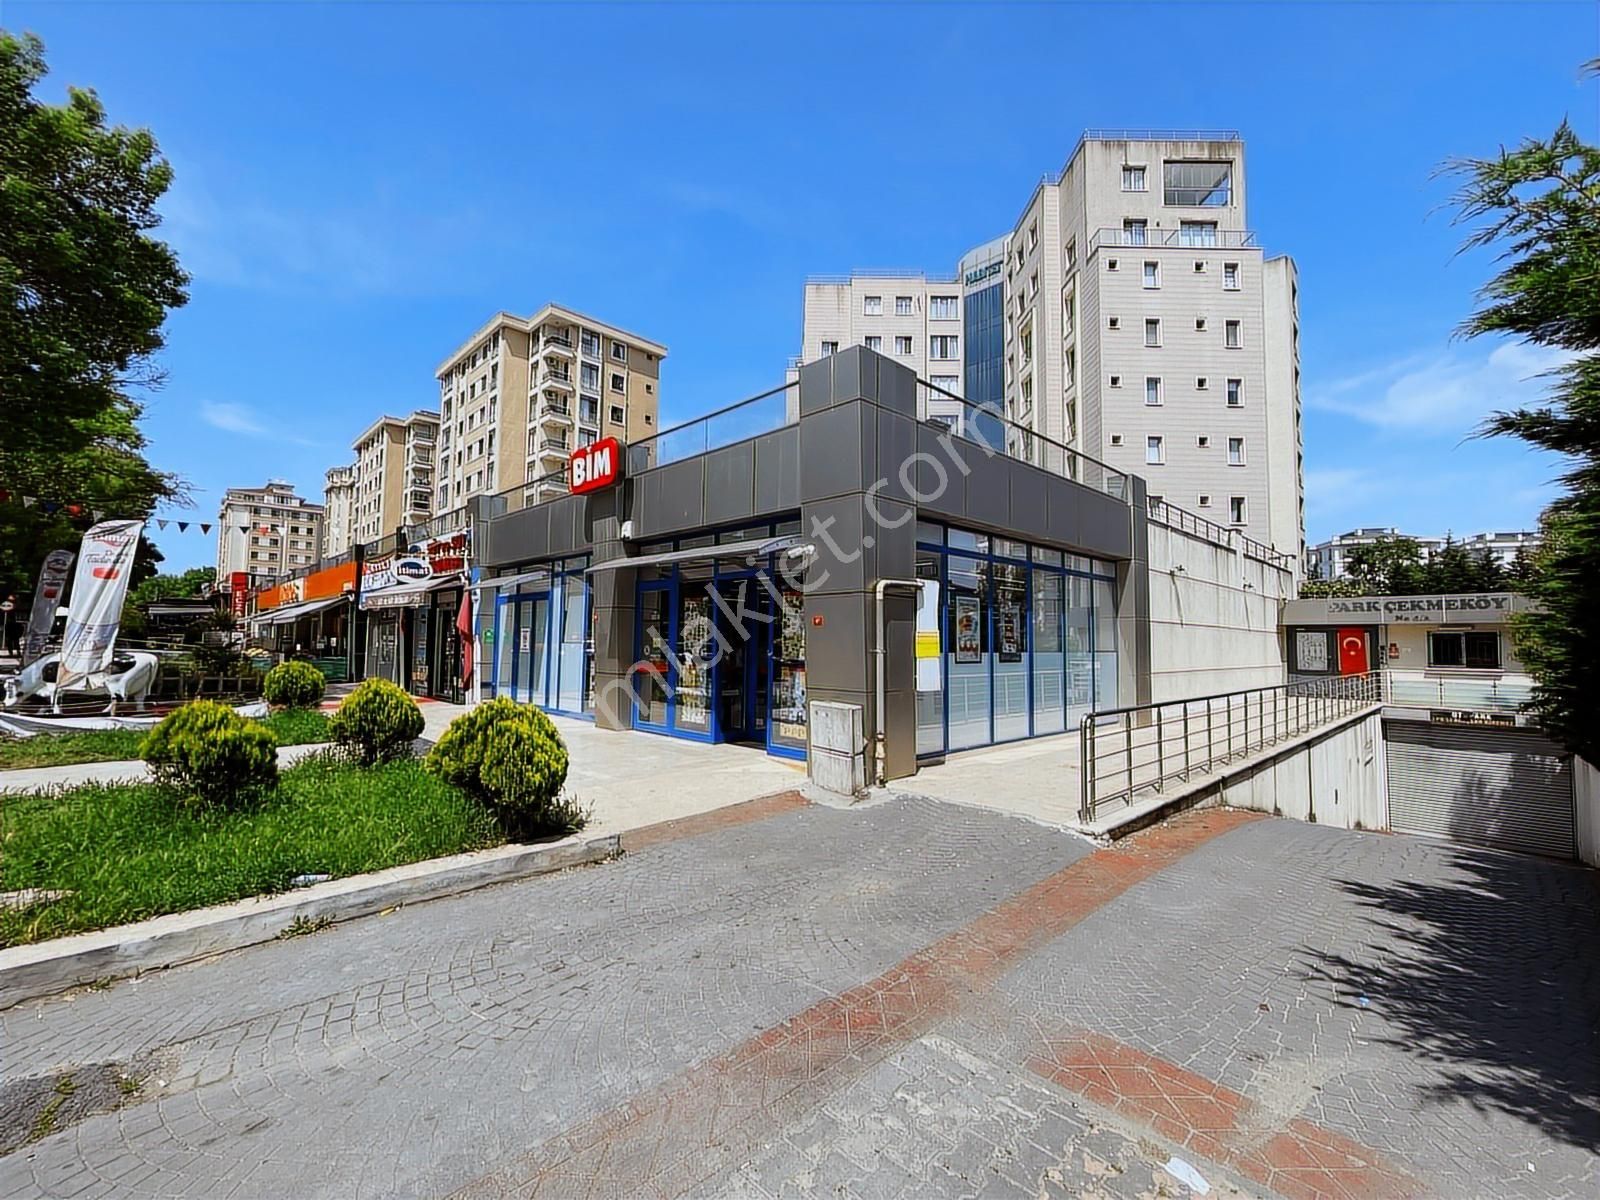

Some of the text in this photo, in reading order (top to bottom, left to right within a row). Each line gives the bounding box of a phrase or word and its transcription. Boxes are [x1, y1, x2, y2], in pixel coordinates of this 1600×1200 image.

[572, 446, 611, 487] BİM
[1327, 595, 1508, 614] PARK ÇEKMEKÖY
